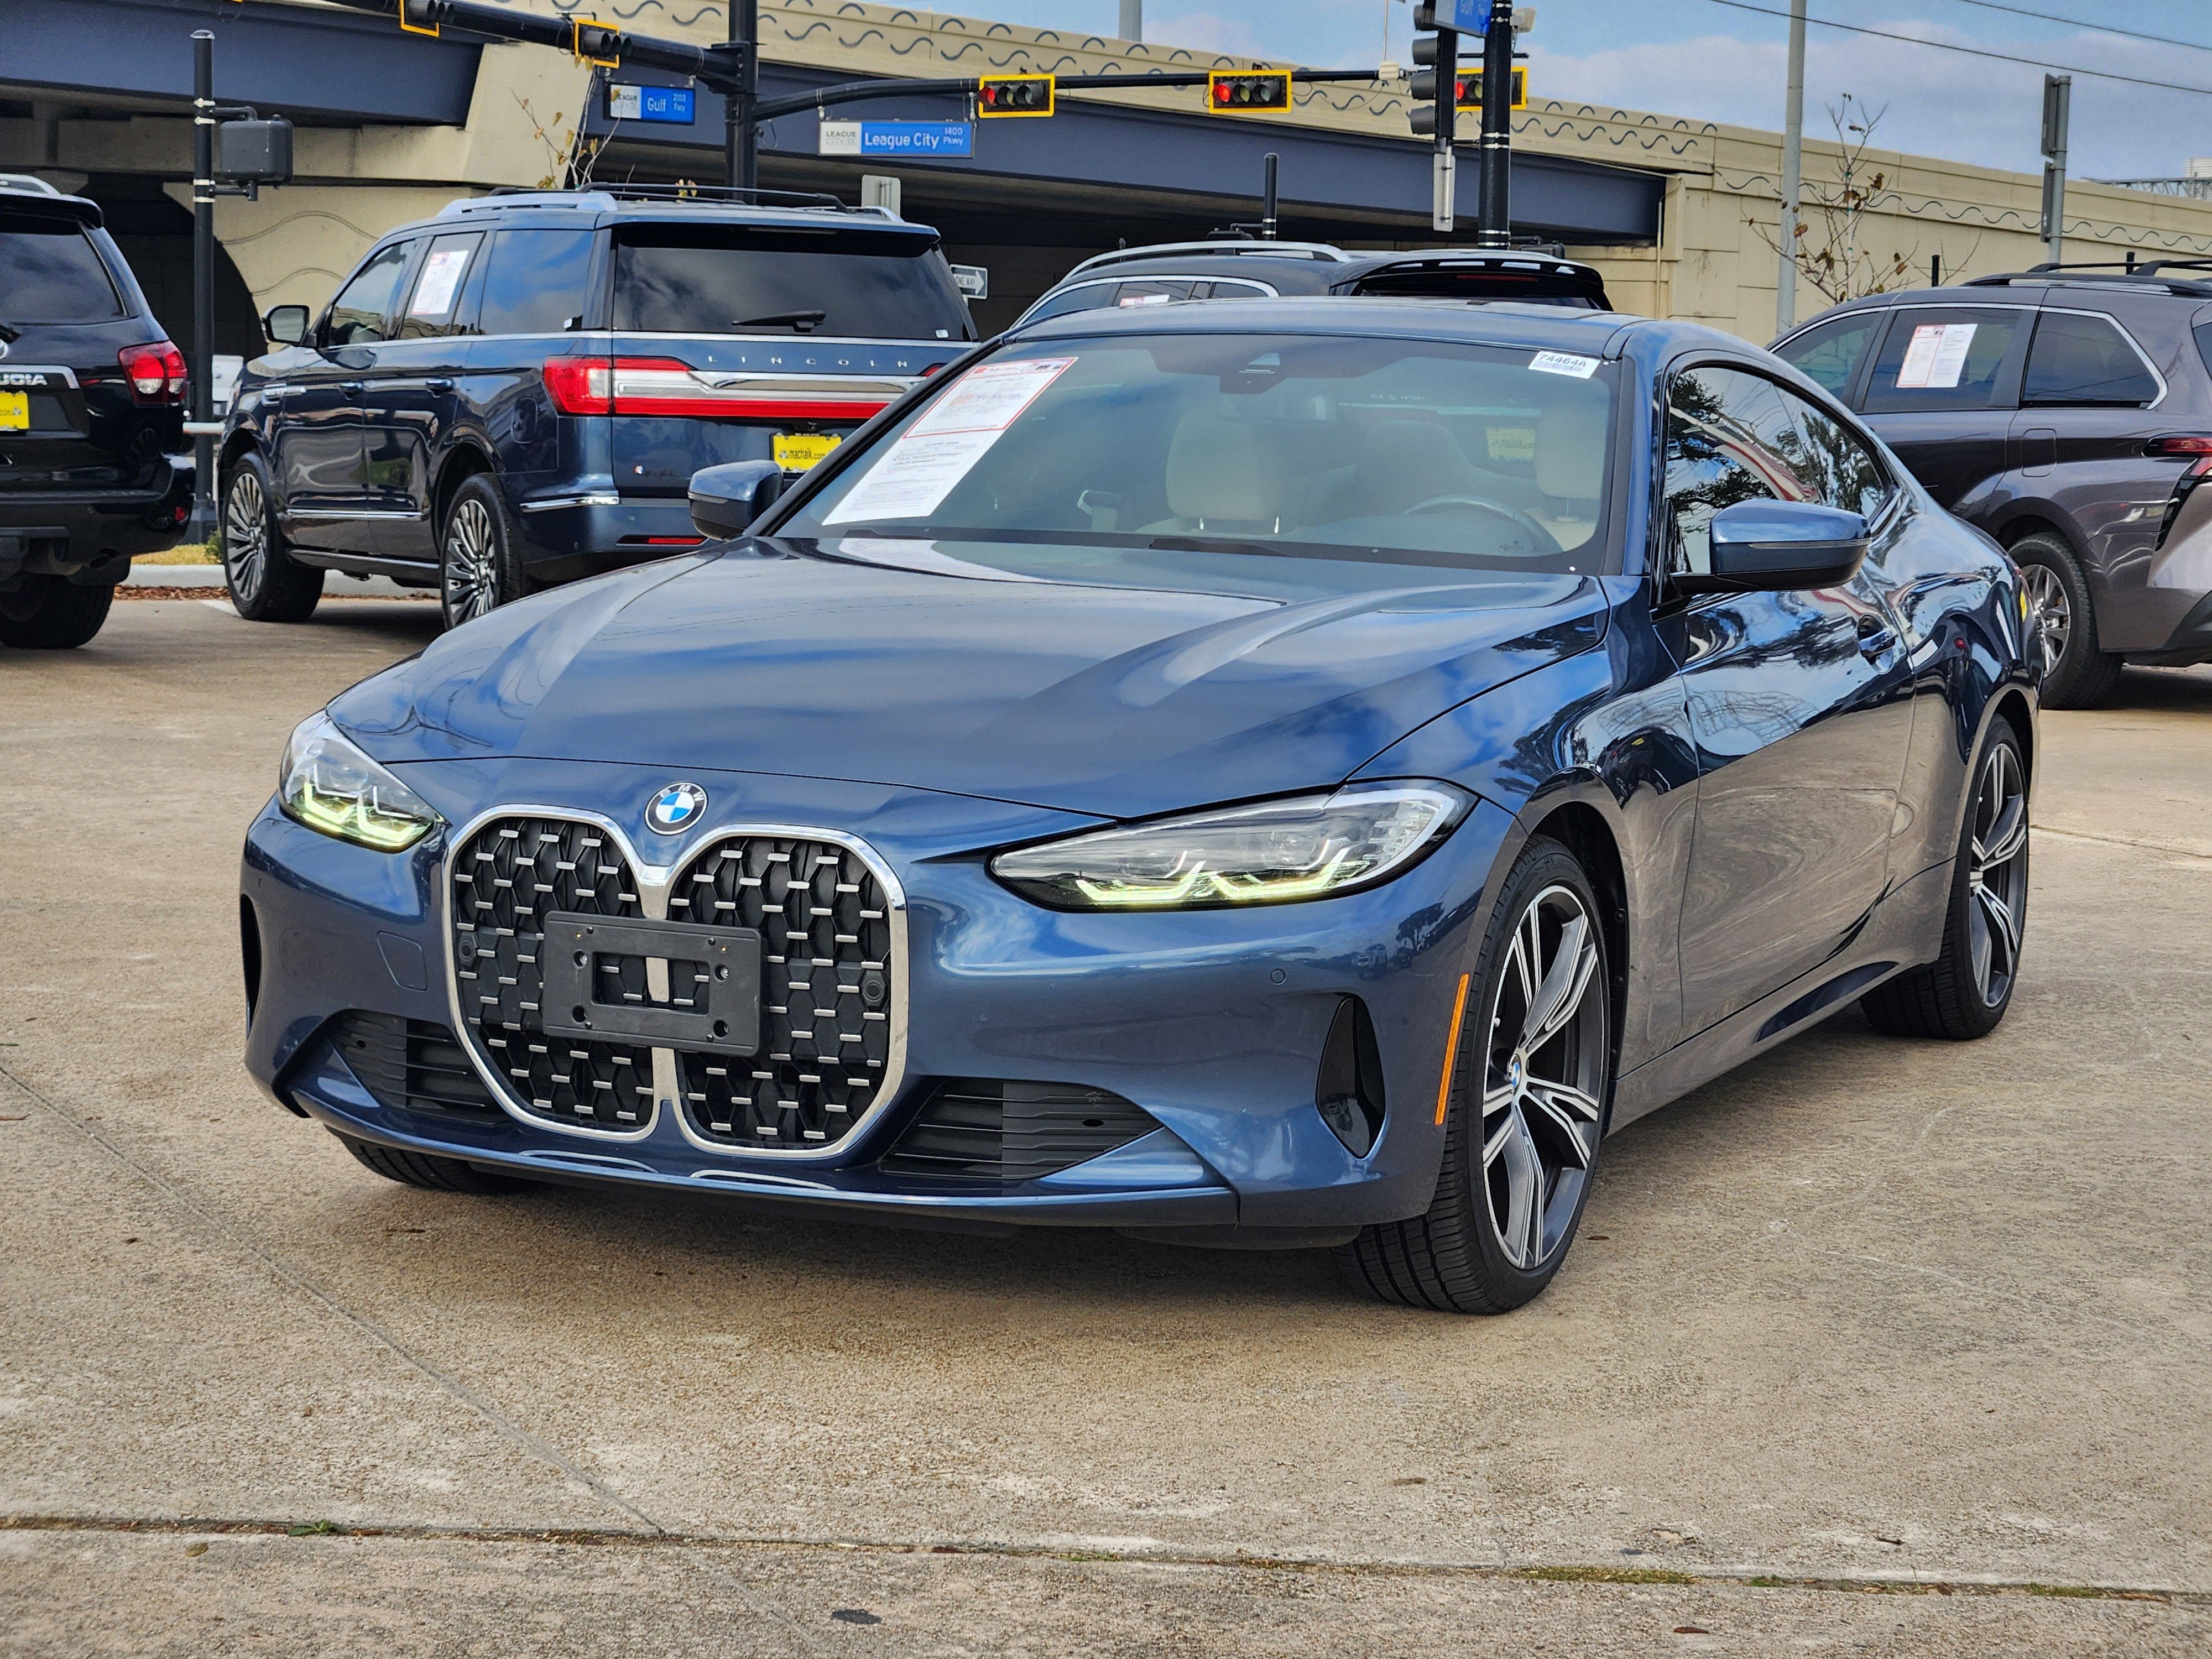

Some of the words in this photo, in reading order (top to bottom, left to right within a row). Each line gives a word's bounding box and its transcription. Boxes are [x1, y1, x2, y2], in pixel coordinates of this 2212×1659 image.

[615, 93, 638, 102] EAGUE
[647, 97, 666, 112] Gulf
[944, 127, 963, 135] 1400
[864, 132, 911, 150] League
[914, 133, 940, 150] City
[943, 137, 964, 147] Pkwy
[708, 355, 907, 368] LINCOLN
[659, 784, 705, 801] BMW
